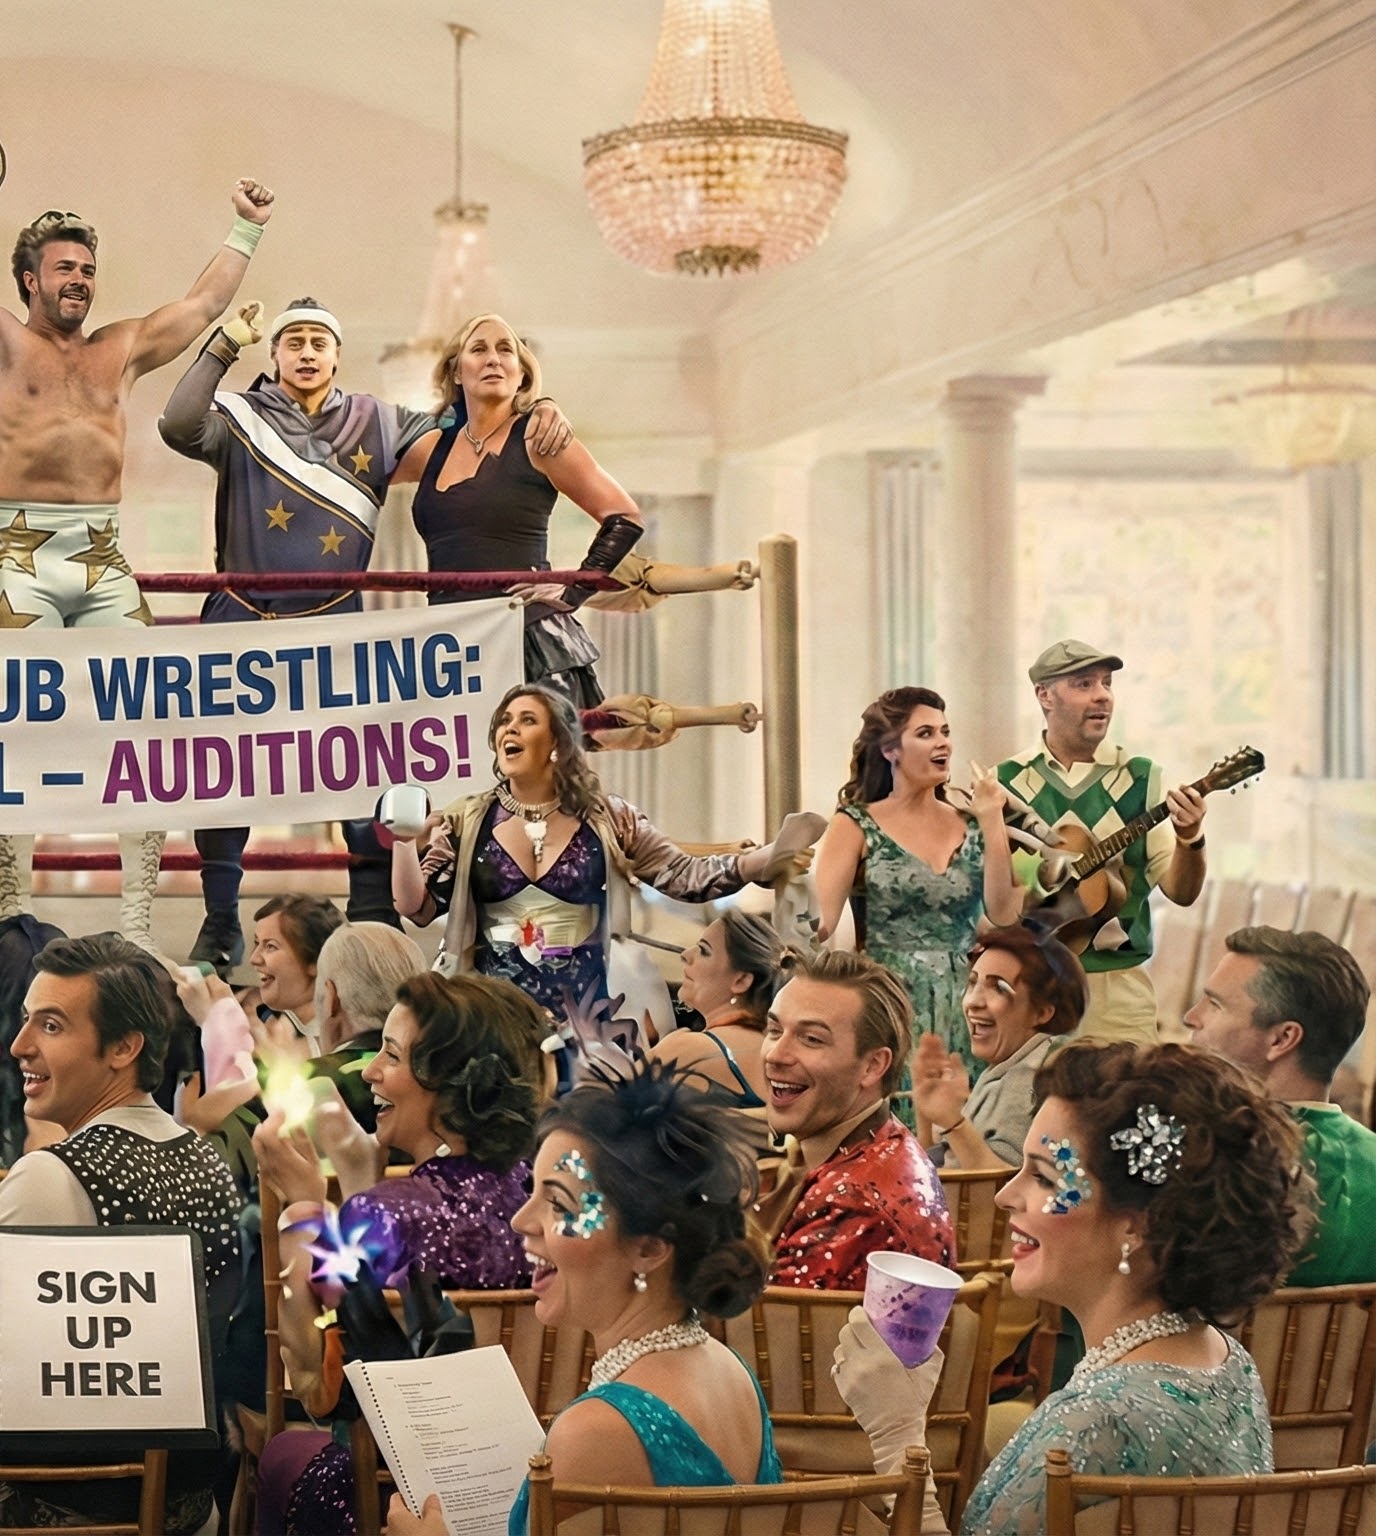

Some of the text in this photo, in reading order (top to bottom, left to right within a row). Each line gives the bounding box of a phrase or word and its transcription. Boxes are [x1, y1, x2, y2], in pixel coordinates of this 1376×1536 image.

[87, 633, 483, 722] WRESTLING:
[101, 714, 474, 805] AUDITIONS!
[37, 1270, 157, 1305] SIGN
[66, 1316, 132, 1350] UP
[41, 1362, 163, 1397] HERE
